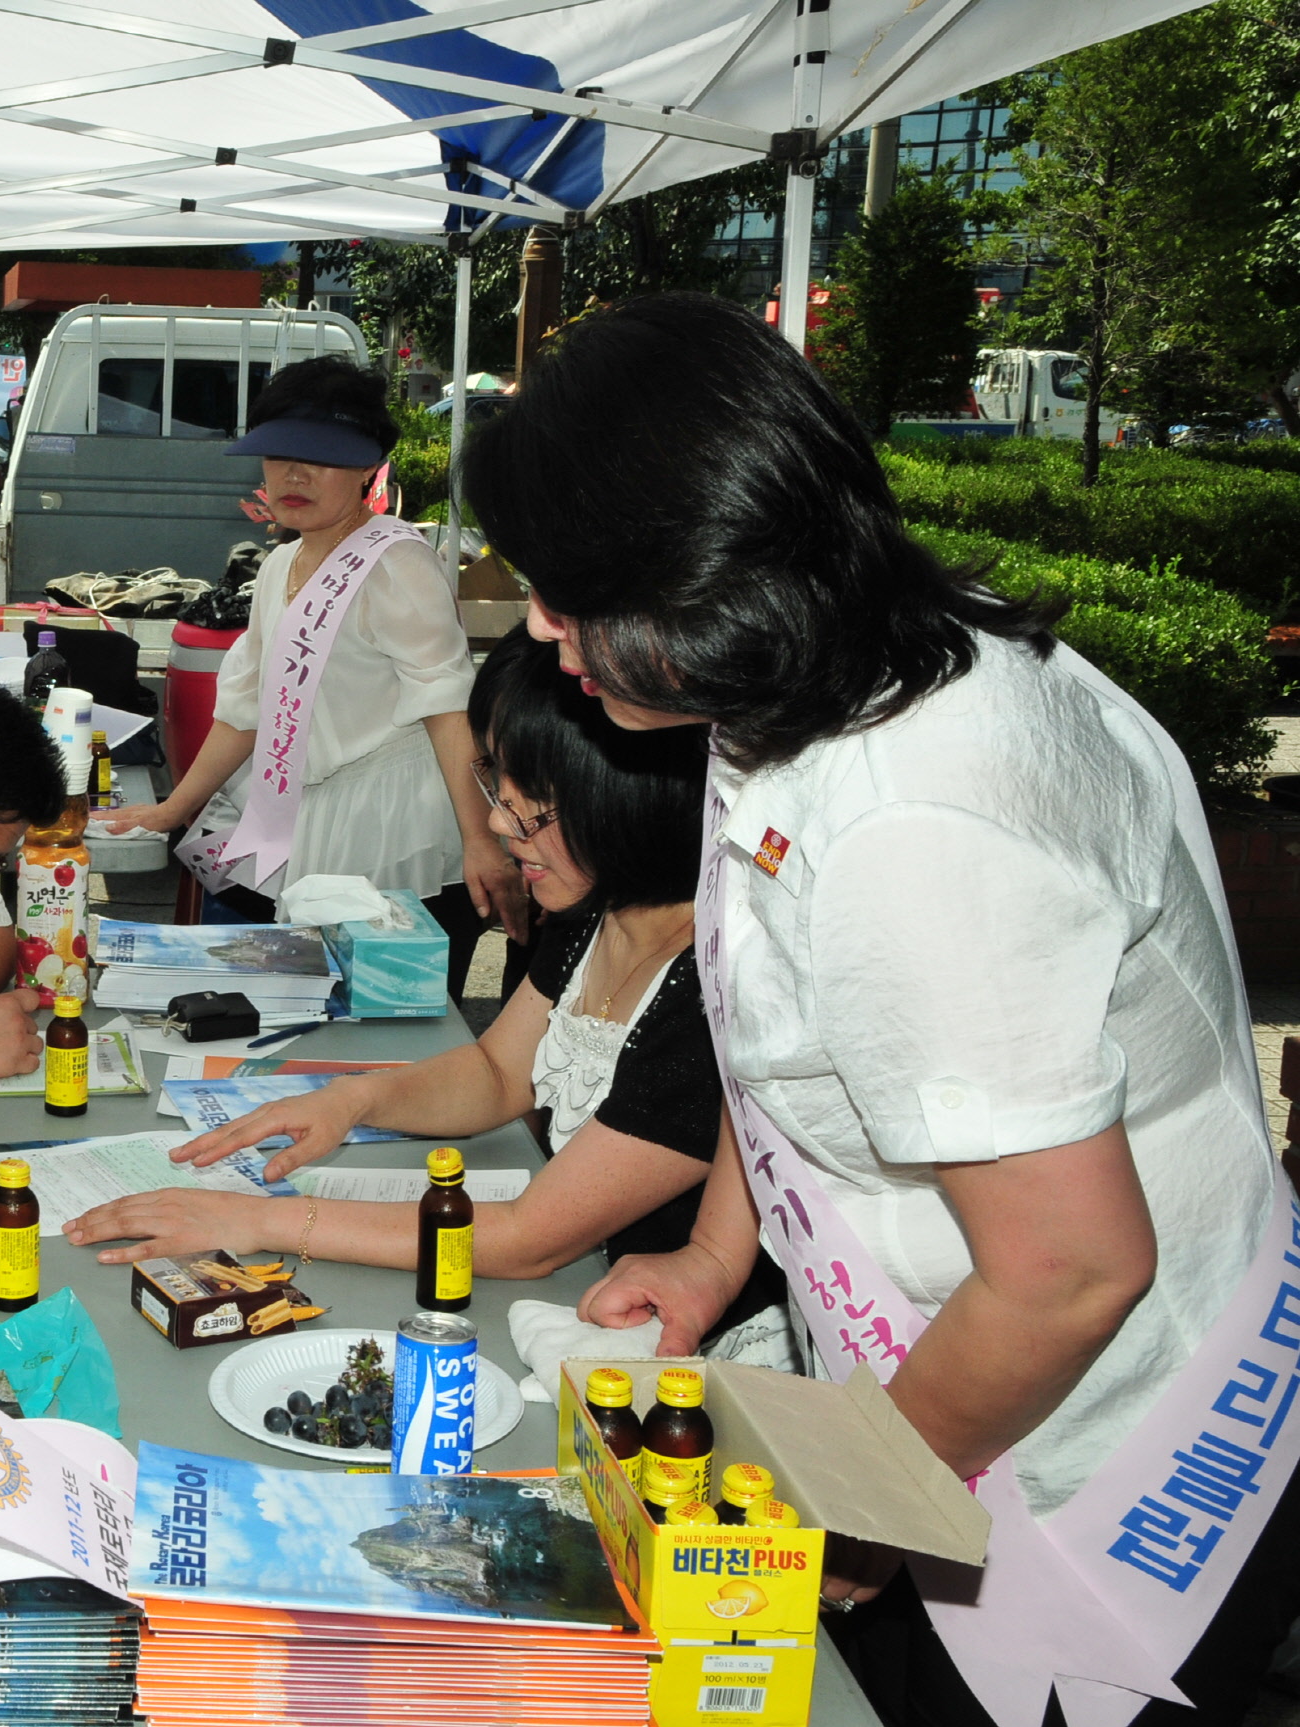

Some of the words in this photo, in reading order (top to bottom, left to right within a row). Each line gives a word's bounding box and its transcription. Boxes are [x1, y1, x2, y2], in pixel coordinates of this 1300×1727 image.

[763, 841, 781, 859] END
[756, 854, 777, 874] NOW
[26, 886, 70, 905] 자연은
[89, 1482, 129, 1591] 국제로타리
[152, 1515, 171, 1541] Korea
[674, 1535, 701, 1544] 마시자
[705, 1535, 732, 1544] 상큼한
[149, 1542, 171, 1571] Rotary
[673, 1548, 750, 1576] 비타천
[754, 1549, 807, 1571] PLUS
[753, 1569, 783, 1578] 플러스
